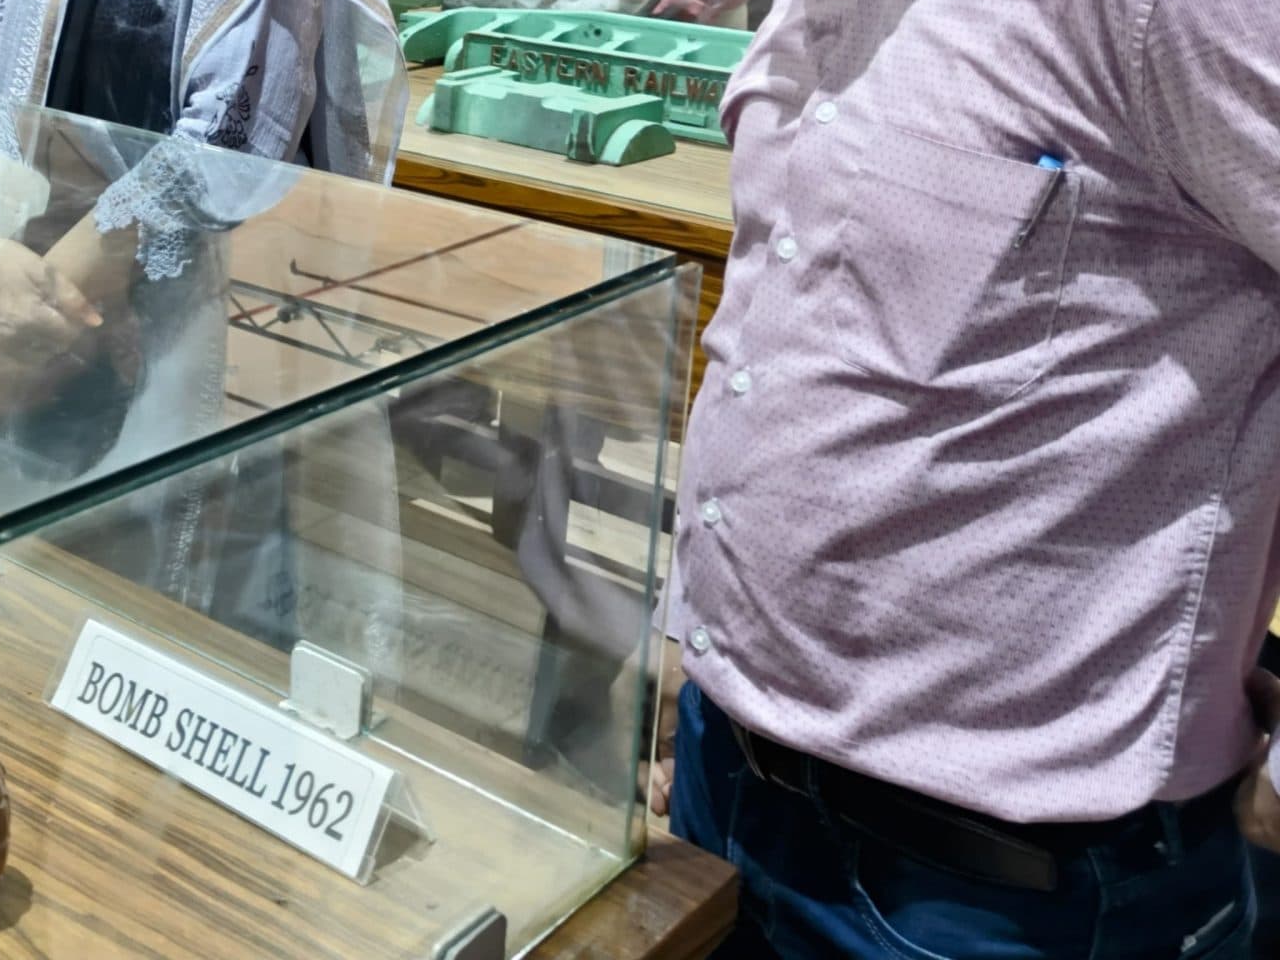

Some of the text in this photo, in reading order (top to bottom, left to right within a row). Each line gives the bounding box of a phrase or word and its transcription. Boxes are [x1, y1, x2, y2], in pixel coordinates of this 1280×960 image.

[489, 44, 610, 88] EASTERN
[76, 661, 355, 842] BOMB SHELL 1962
